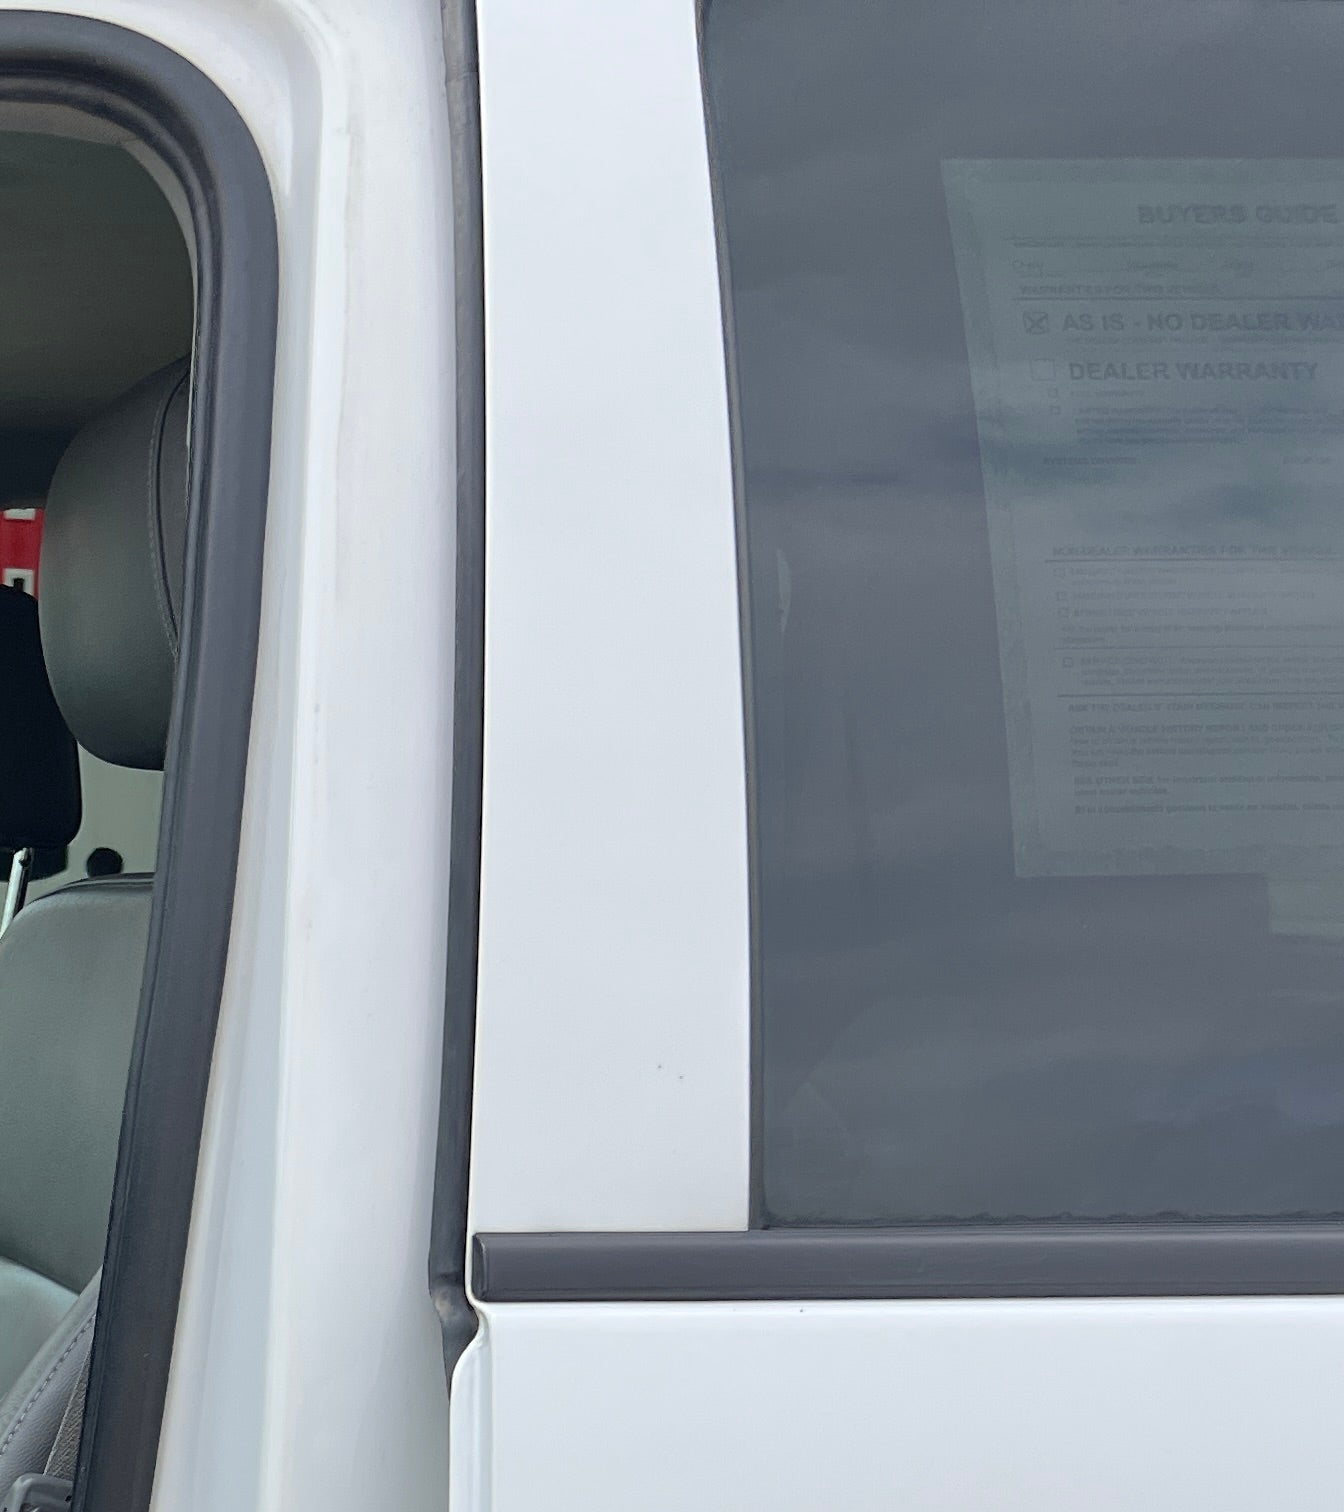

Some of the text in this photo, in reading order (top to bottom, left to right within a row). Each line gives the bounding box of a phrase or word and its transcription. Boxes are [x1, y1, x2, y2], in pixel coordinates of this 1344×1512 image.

[1138, 203, 1339, 224] BUYERS GUIDE
[1062, 313, 1094, 332] AS
[1102, 313, 1125, 332] IS
[1147, 313, 1184, 332] NO
[1190, 312, 1292, 332] DEALER
[1069, 361, 1319, 381] DEALER WARRANTY
